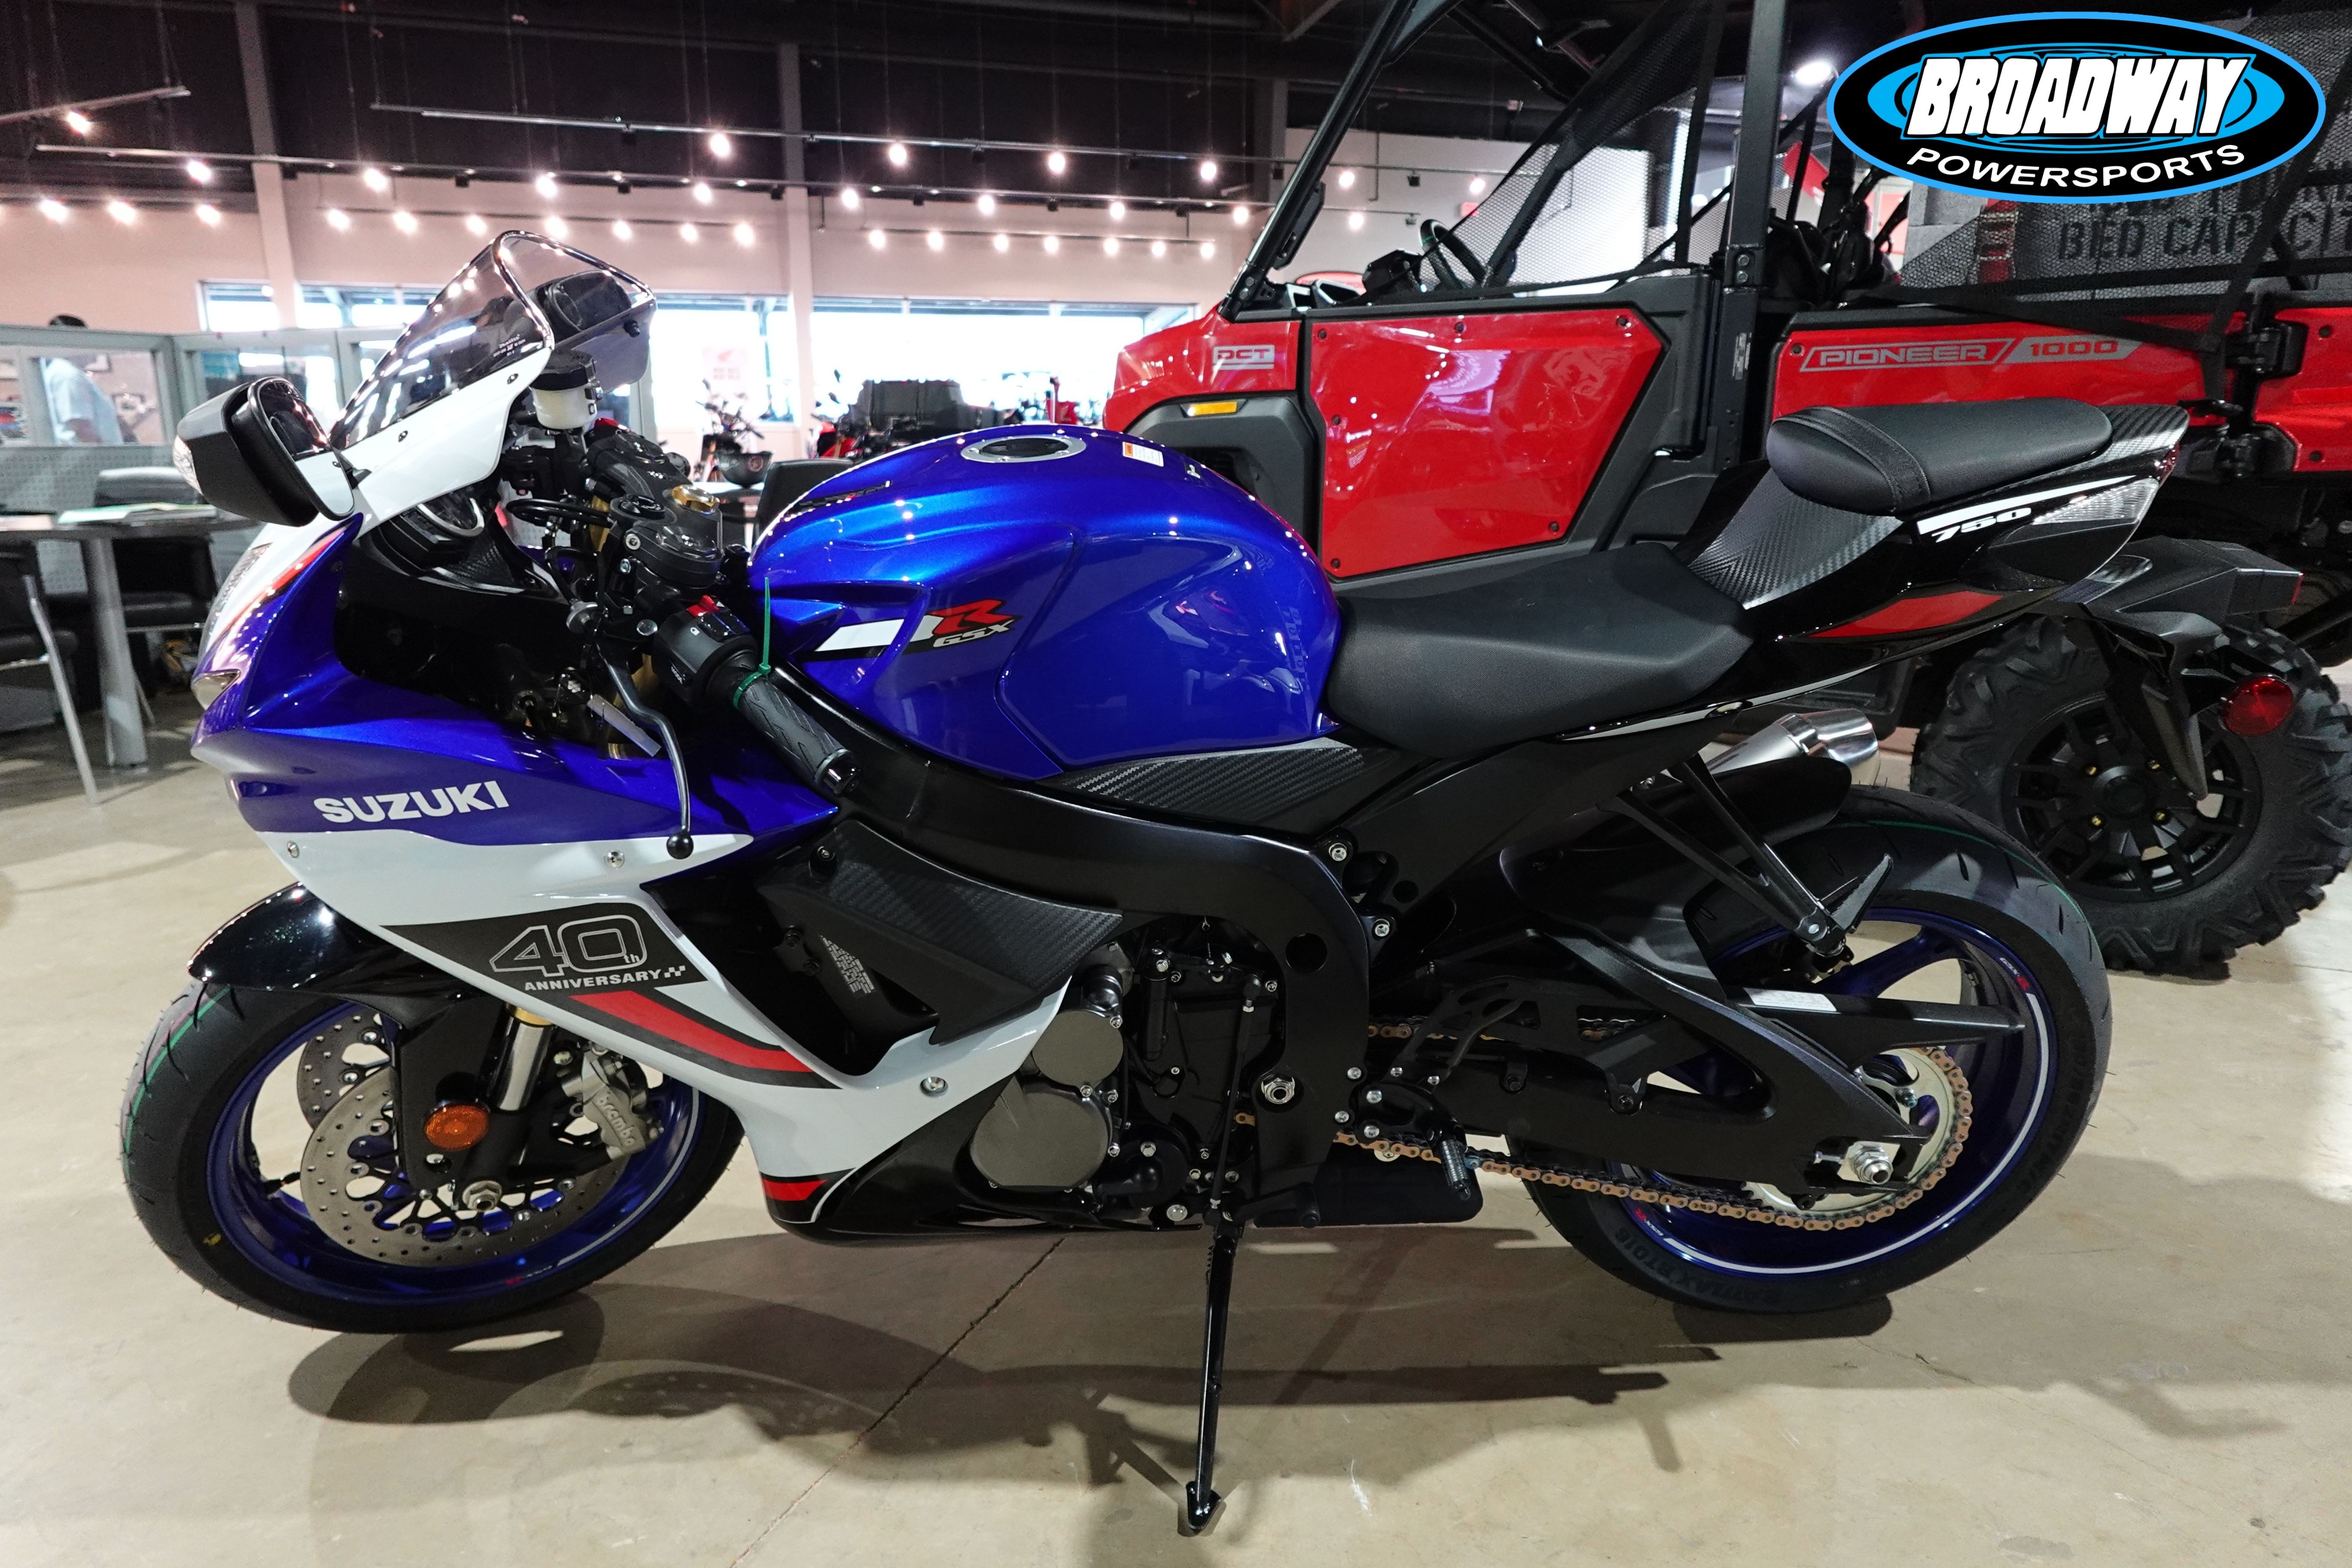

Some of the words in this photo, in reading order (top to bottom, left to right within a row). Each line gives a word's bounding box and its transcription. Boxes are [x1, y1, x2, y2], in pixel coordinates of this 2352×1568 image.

[2058, 217, 2146, 260] BED
[1218, 349, 1270, 360] DCT
[1820, 345, 1986, 366] PIONEER
[2030, 340, 2118, 357] 1000
[1932, 507, 2031, 542] 750
[933, 619, 1015, 648] GSX
[314, 781, 509, 823] SUZUKI
[524, 969, 662, 991] ANNIVERSARY
[597, 1094, 635, 1145] brembo
